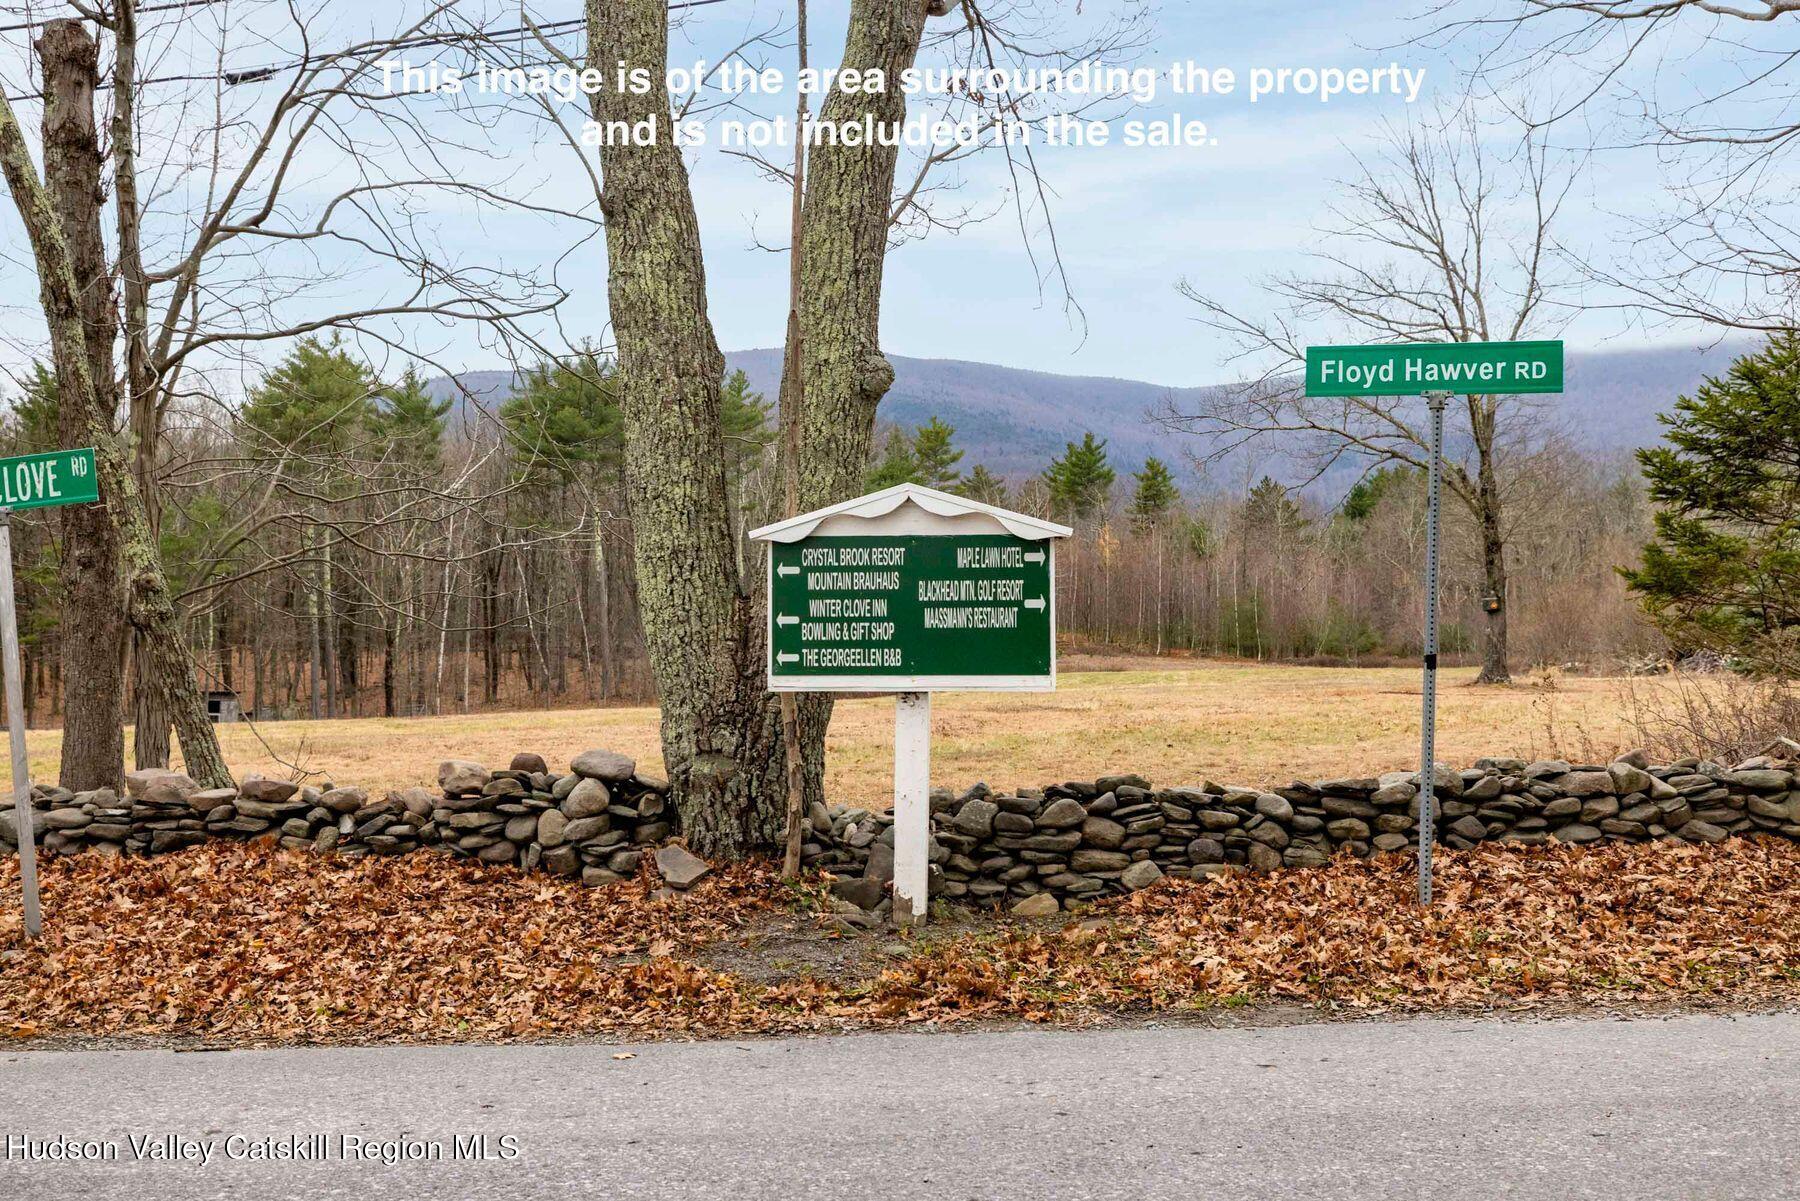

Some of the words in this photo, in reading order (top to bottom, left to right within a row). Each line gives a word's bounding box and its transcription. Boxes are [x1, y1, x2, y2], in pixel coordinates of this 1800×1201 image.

[1321, 359, 1394, 389] Floyd
[1405, 358, 1506, 382] Hawver
[1515, 361, 1547, 379] RD
[0, 460, 61, 503] LOVE
[71, 456, 87, 477] RD
[802, 548, 838, 566] CRYSTAL
[840, 548, 870, 566] BROOK
[872, 547, 905, 565] RESORT
[957, 547, 980, 568] MAPLE
[981, 547, 1000, 568] LAWN
[1001, 547, 1024, 567] HOTEL
[808, 572, 851, 590] MOUNTAIN
[853, 572, 899, 590] BRAUHAUS
[919, 580, 959, 601] BLACKHEAD
[960, 580, 977, 601] MTN.
[978, 580, 996, 601] GOLF
[997, 580, 1024, 601] RESORT
[809, 599, 841, 617] WINTER
[843, 599, 870, 617] CLOVE
[872, 599, 887, 617] INN
[924, 607, 973, 628] MAASSMANN'S
[974, 607, 1018, 628] RESTAURANT
[802, 623, 841, 640] BOWLING
[842, 623, 849, 640] &
[850, 623, 870, 640] GIFT
[871, 623, 895, 640] SHOP
[802, 648, 819, 666] THE
[820, 648, 882, 666] GEORGEELLEN
[883, 648, 902, 666] B&B
